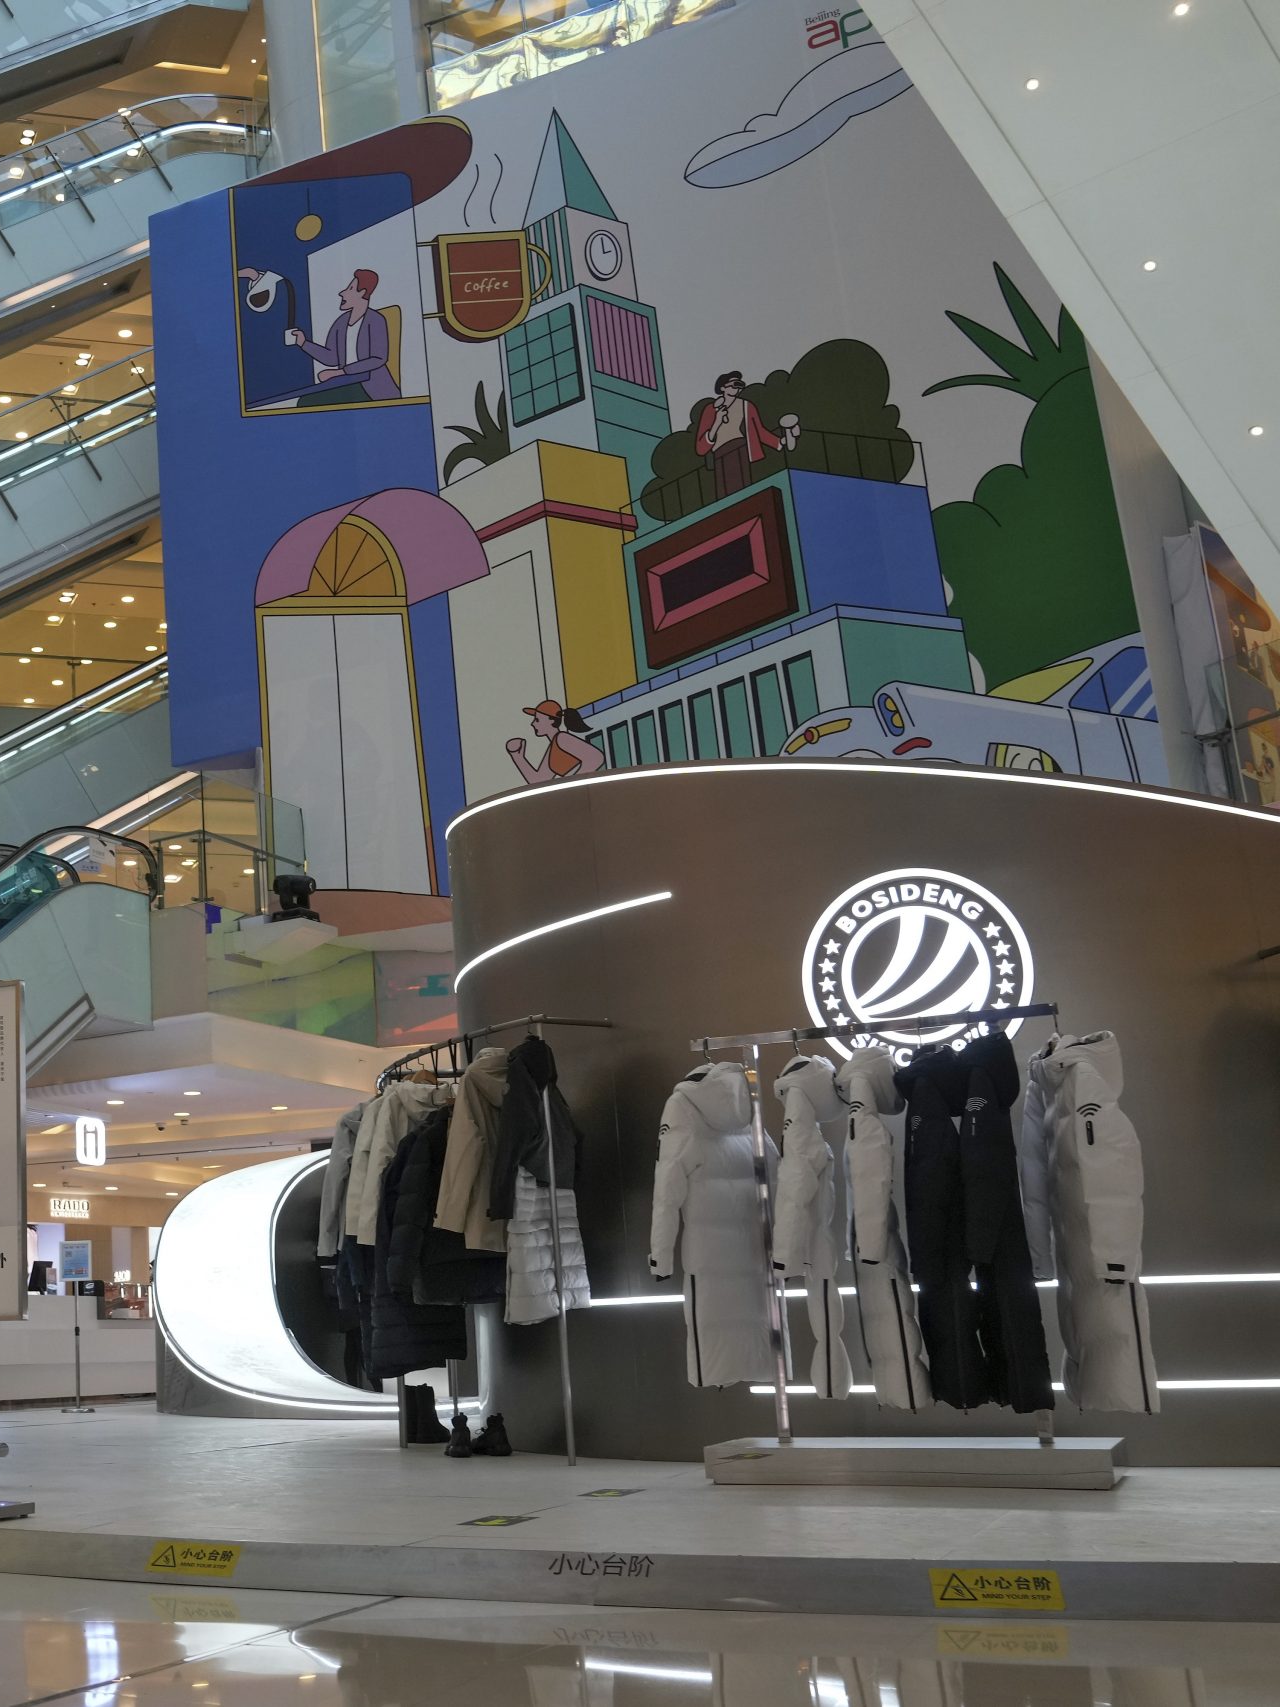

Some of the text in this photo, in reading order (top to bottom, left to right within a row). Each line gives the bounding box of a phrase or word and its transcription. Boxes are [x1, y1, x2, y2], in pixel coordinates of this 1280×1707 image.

[805, 9, 840, 26] Beijing
[806, 8, 873, 49] ap
[835, 883, 985, 935] BOSIDENG
[53, 1199, 90, 1212] RADO
[181, 1548, 234, 1562] 小心台阶
[548, 1553, 654, 1577] 小心台阶
[974, 1575, 1052, 1591] 小心台阶
